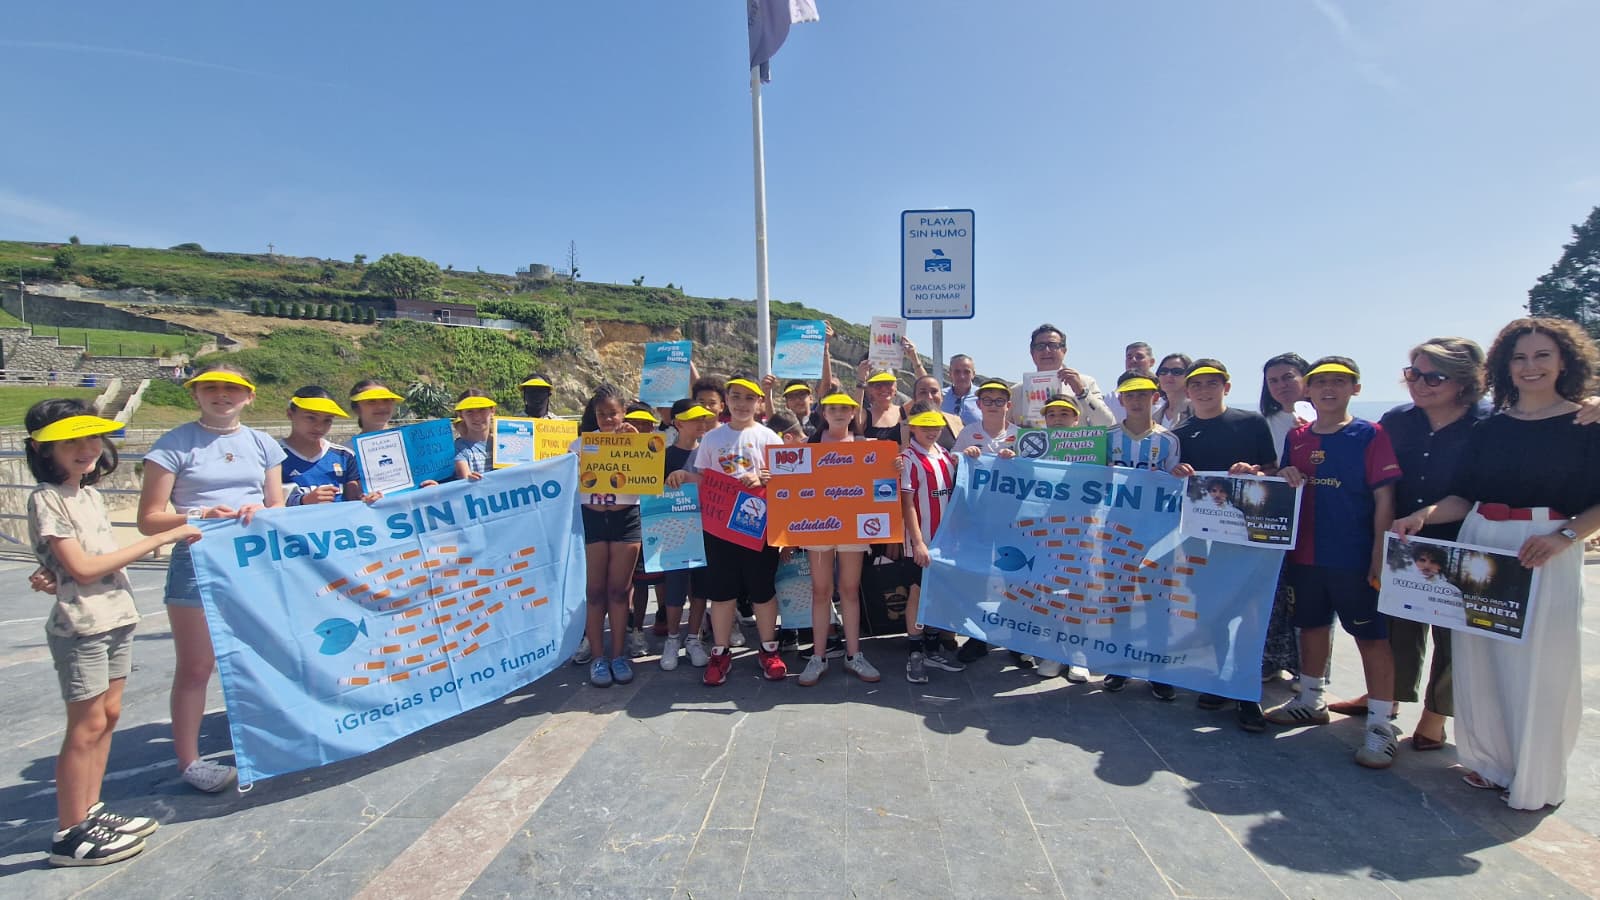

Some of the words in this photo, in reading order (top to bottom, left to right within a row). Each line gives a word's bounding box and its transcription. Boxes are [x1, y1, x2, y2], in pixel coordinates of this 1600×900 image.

[920, 217, 956, 226] PLAYA
[909, 229, 928, 239] SIN
[931, 228, 967, 238] HUMO
[948, 283, 966, 291] POR
[931, 292, 961, 300] FUMAR
[1051, 429, 1104, 439] Nuestras
[584, 436, 632, 446] DISFRUTA
[1055, 440, 1095, 451] playas
[623, 450, 654, 460] PLAYA,
[775, 448, 804, 465] NO!
[817, 452, 854, 467] Ahora
[586, 463, 620, 472] APAGA
[621, 464, 632, 472] EL
[627, 475, 657, 484] HUMO
[1309, 476, 1342, 489] Spotify
[776, 488, 790, 499] es
[799, 488, 815, 498] un
[824, 486, 864, 500] espacio
[972, 468, 1071, 501] Playas
[1081, 480, 1143, 510] SIN
[656, 491, 685, 499] Playas
[671, 504, 697, 512] humo
[234, 523, 377, 567] Playas
[386, 500, 457, 539] SIN
[466, 478, 563, 520] humo
[788, 516, 843, 532] saludable
[1247, 521, 1288, 531] PLANETA
[1392, 578, 1432, 592] FUMAR
[1434, 586, 1452, 595] NO
[1463, 593, 1489, 603] BUENO
[1508, 600, 1520, 609] TI
[1465, 602, 1518, 619] PLANETA
[981, 610, 1051, 638] ¡Gracias
[1056, 626, 1089, 647] por
[1093, 638, 1118, 655] no
[1123, 644, 1188, 666] fumar!
[335, 693, 424, 735] ¡Gracias
[430, 677, 465, 702] por
[470, 665, 495, 683] no
[500, 639, 557, 674] fumar!
